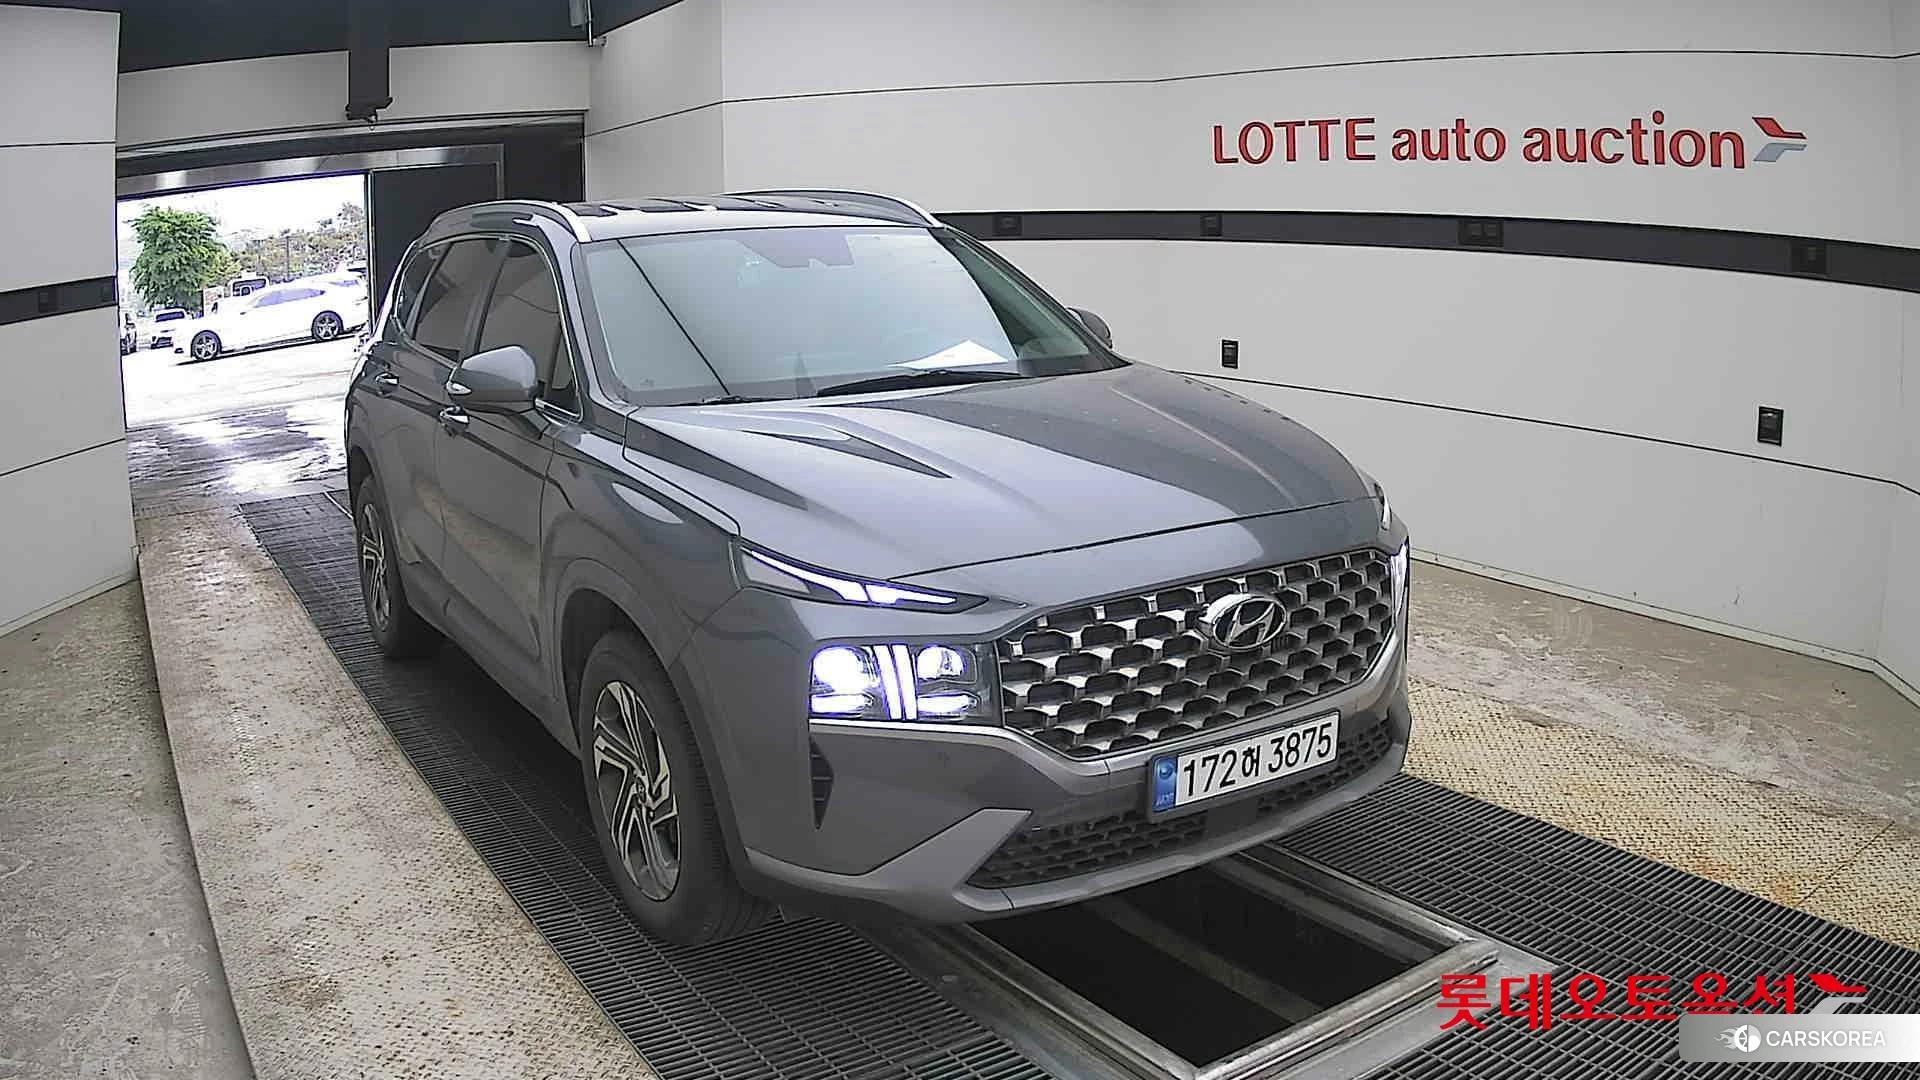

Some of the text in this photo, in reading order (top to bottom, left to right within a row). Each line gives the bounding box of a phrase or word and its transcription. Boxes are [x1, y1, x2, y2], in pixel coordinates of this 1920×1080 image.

[1212, 110, 1746, 169] LOTTE auto auction
[1183, 721, 1333, 797] 172허 3875
